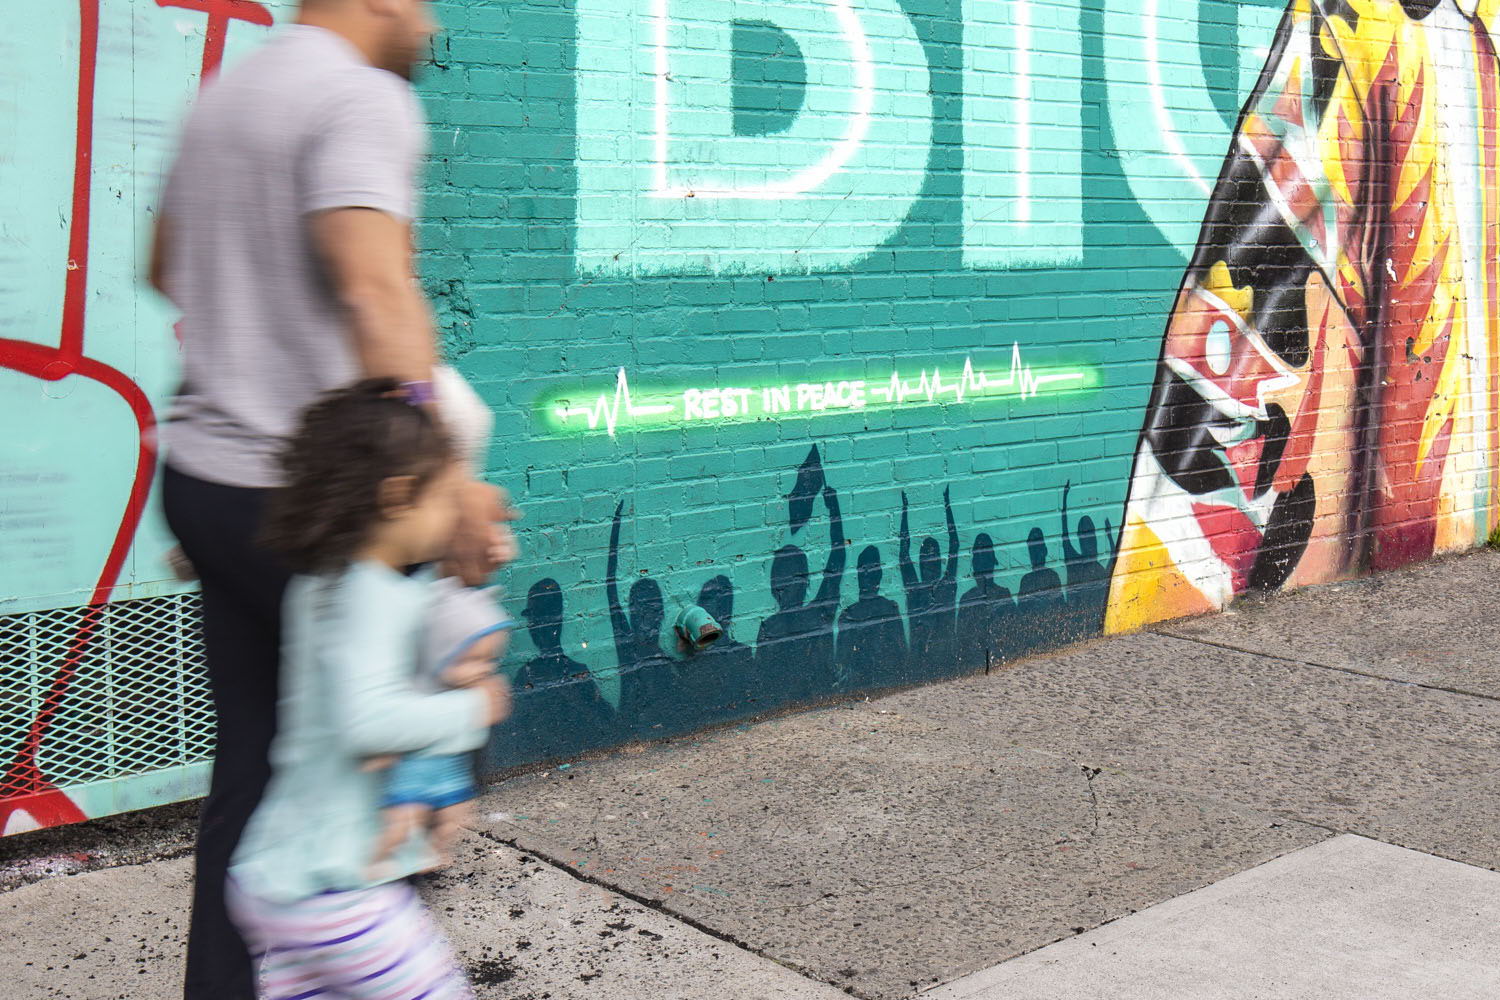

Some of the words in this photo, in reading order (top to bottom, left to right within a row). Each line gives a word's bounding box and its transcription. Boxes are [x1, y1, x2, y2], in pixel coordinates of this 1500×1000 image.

[683, 385, 751, 421] REST
[763, 383, 791, 414] IN
[796, 379, 868, 411] PEACE
